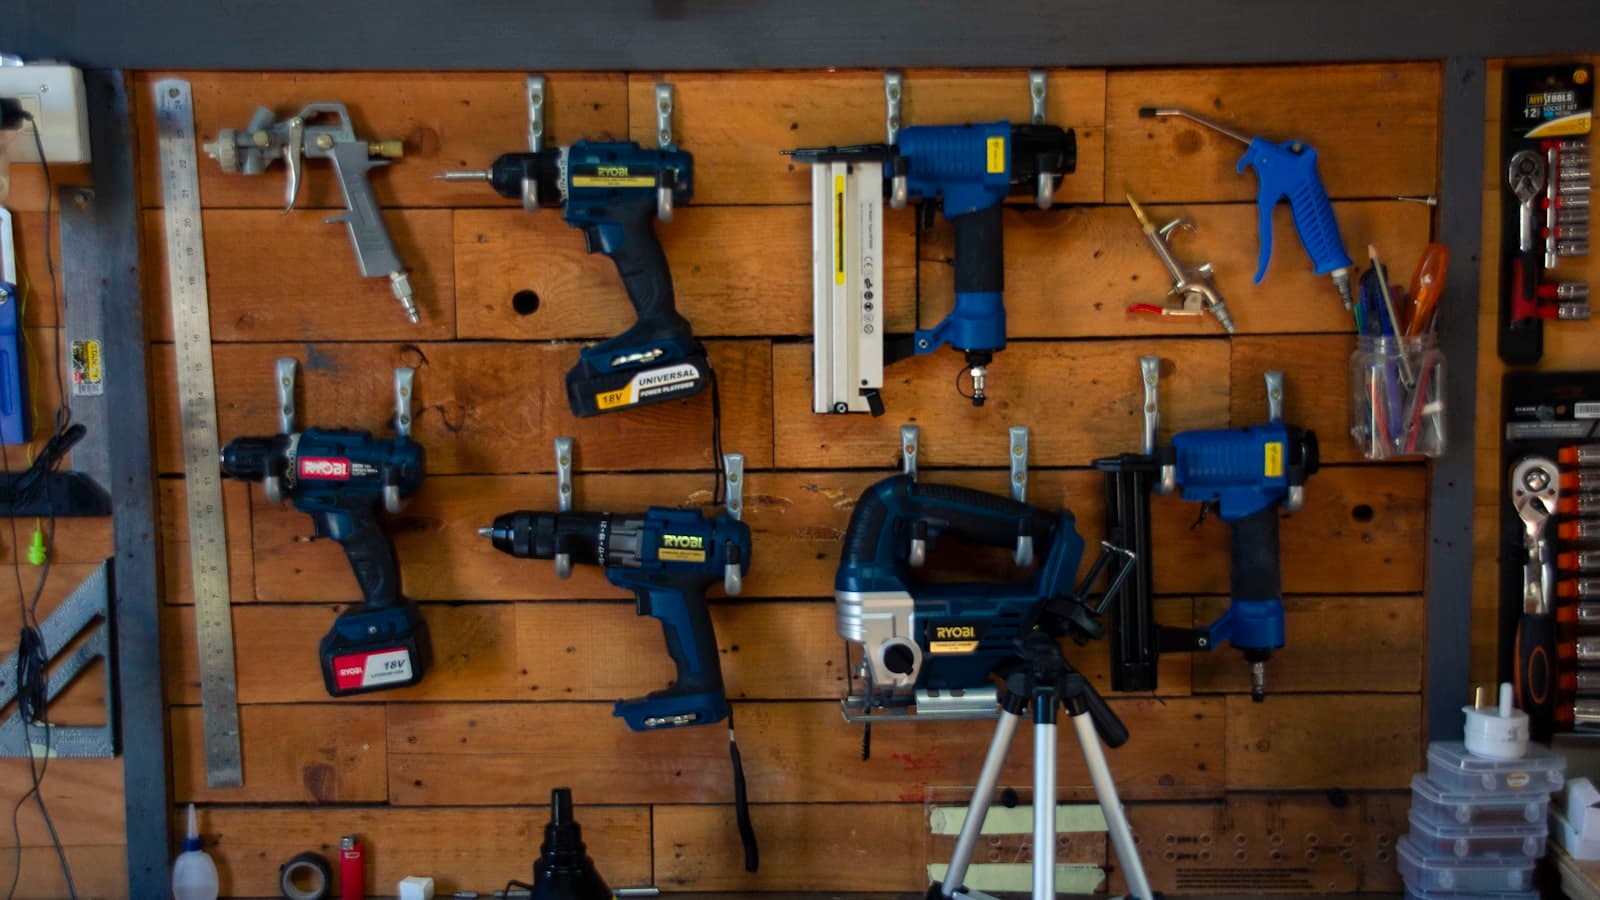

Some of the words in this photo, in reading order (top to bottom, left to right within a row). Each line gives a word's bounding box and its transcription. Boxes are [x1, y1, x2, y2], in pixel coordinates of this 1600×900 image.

[1523, 108, 1537, 118] 12
[597, 167, 628, 177] RYOBI
[639, 369, 695, 386] UNIVERSAL
[603, 393, 623, 404] 18V
[663, 534, 704, 548] RYOBI
[936, 626, 975, 639] RYOBI
[384, 659, 405, 671] 18V
